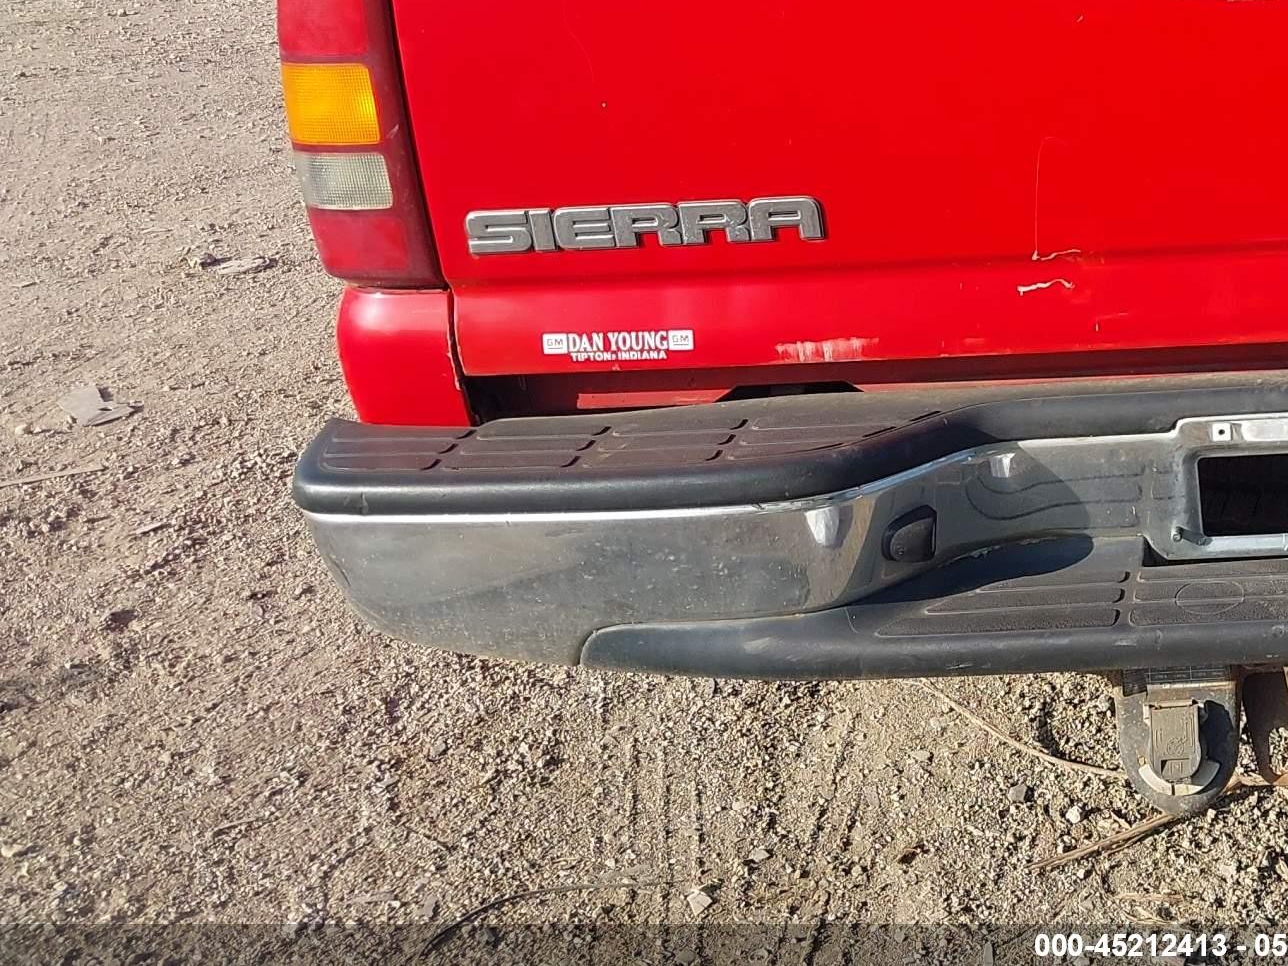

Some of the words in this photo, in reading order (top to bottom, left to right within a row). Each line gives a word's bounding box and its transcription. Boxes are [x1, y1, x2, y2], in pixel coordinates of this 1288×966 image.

[465, 195, 824, 256] SIERRA
[546, 337, 564, 347] GM
[568, 333, 604, 352] DAN
[606, 330, 667, 351] YOUNG
[671, 334, 689, 343] GM
[618, 349, 667, 361] INDIANA
